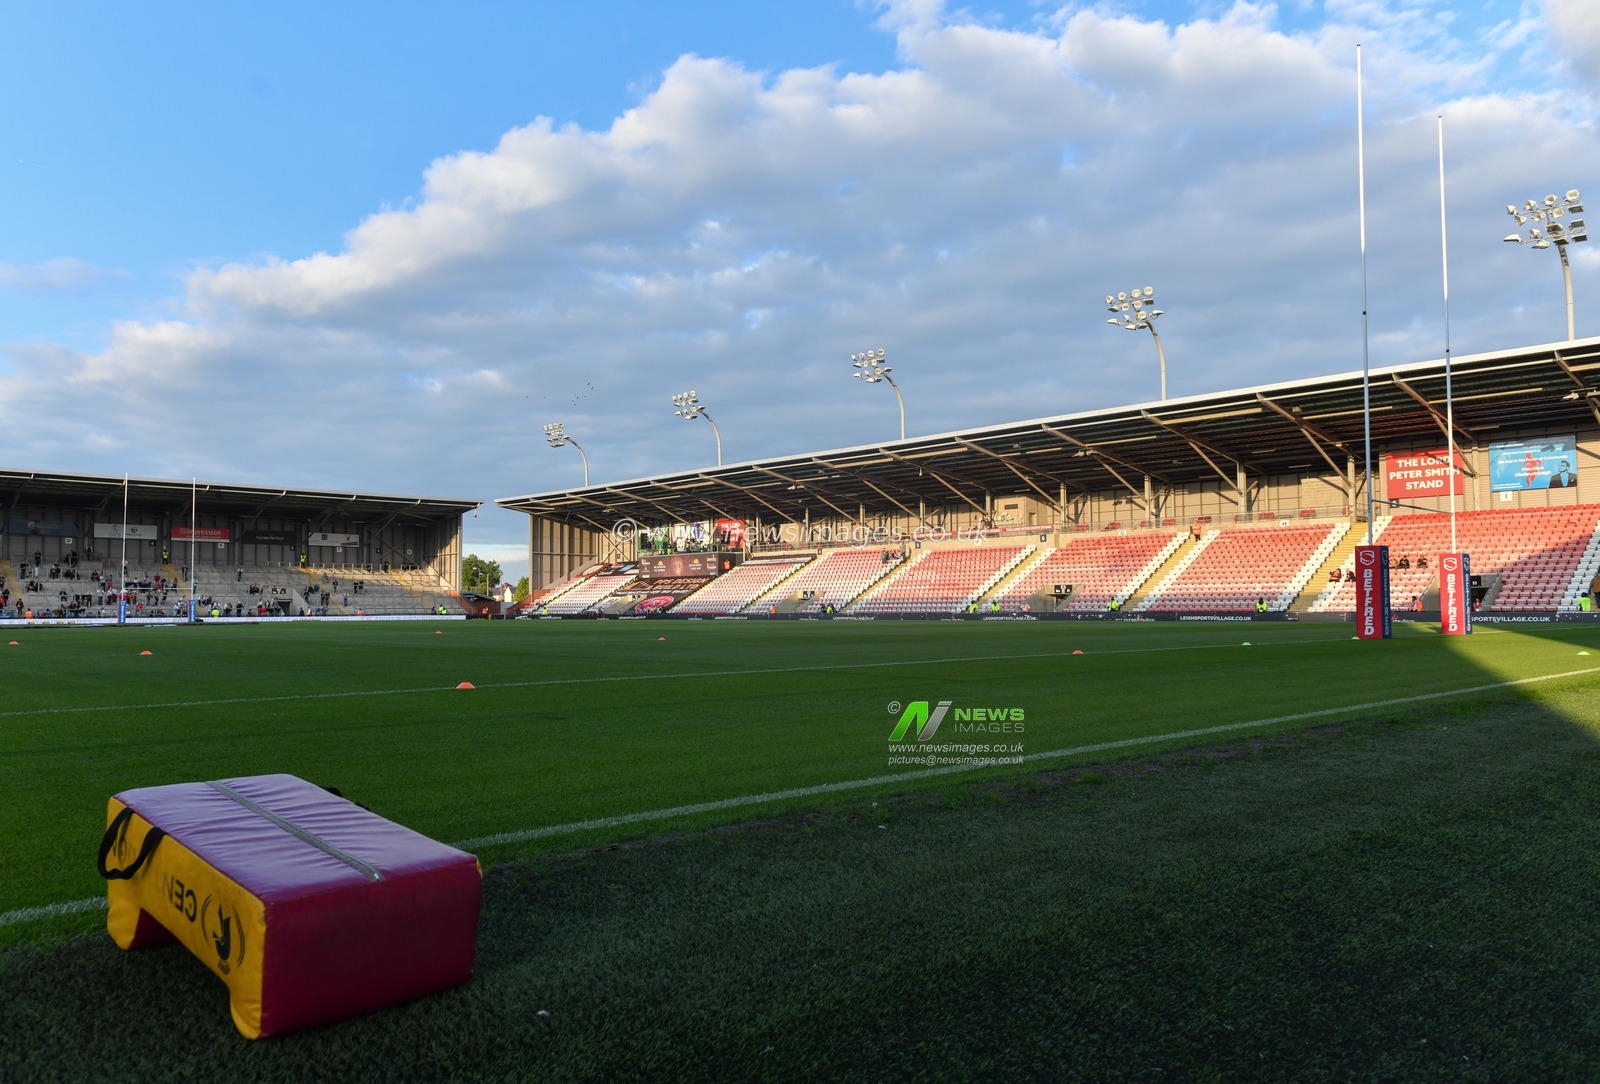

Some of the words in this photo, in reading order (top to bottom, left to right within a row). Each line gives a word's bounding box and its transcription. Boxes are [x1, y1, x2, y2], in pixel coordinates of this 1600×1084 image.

[1396, 458, 1418, 468] THE
[1420, 455, 1450, 466] LORD
[1389, 469, 1422, 480] PETER
[1405, 480, 1444, 490] STAND
[186, 528, 222, 537] impression
[1363, 568, 1375, 636] BETFRED
[1446, 573, 1458, 632] BETFRED
